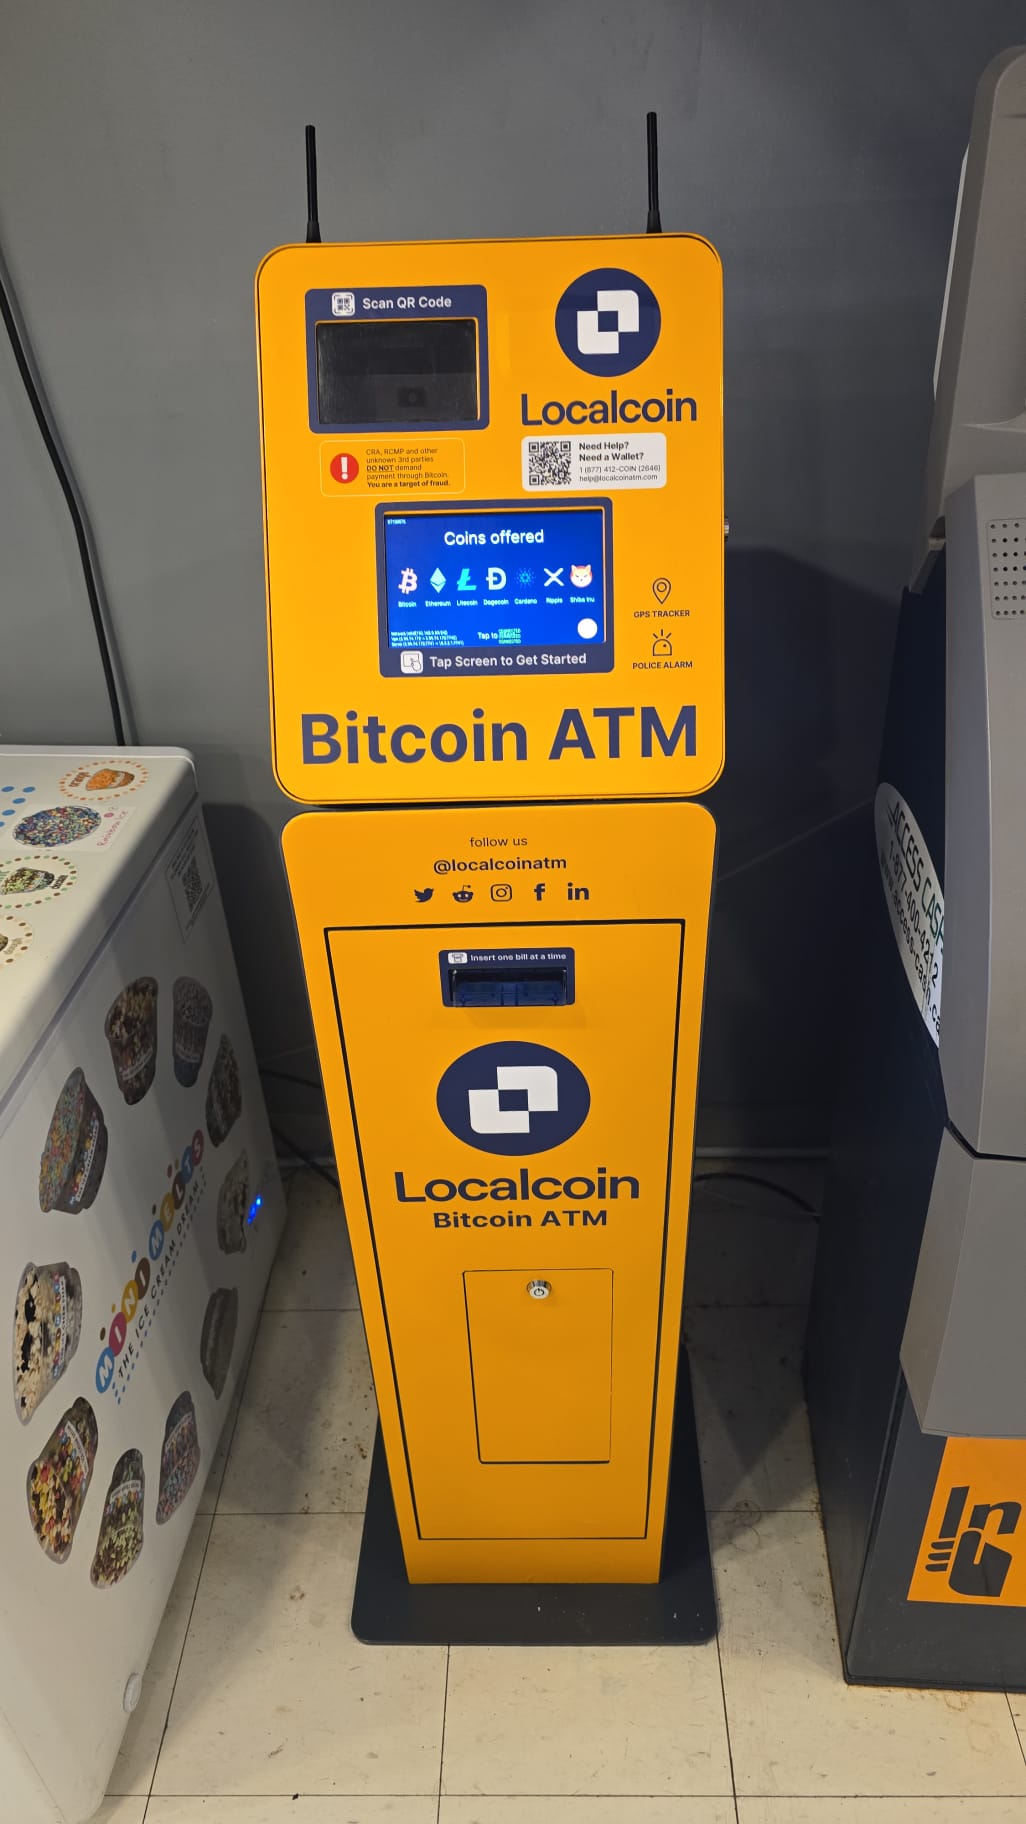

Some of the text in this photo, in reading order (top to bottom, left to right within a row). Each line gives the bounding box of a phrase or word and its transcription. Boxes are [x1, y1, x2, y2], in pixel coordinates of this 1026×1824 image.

[363, 296, 451, 309] Scan QR Code
[521, 389, 697, 426] Localcoin
[604, 442, 629, 451] Help?
[612, 453, 645, 461] Wallet?
[398, 472, 422, 480] through
[444, 529, 544, 545] Coins offered
[634, 609, 691, 618] GPS TRACKER
[429, 653, 586, 669] Tap Screen to Get Started
[632, 661, 693, 670] POLICE ALARM
[302, 705, 696, 764] Bitcoin ATM
[470, 837, 527, 847] follow us
[889, 801, 924, 892] ACCESS
[434, 857, 566, 874] @localcoinatm
[395, 1167, 639, 1202] Localcoin
[434, 1210, 607, 1228] Bitcoin ATM
[97, 1131, 203, 1391] MINI MELTS
[118, 1180, 199, 1378] THE ICE CREAM DREAM
